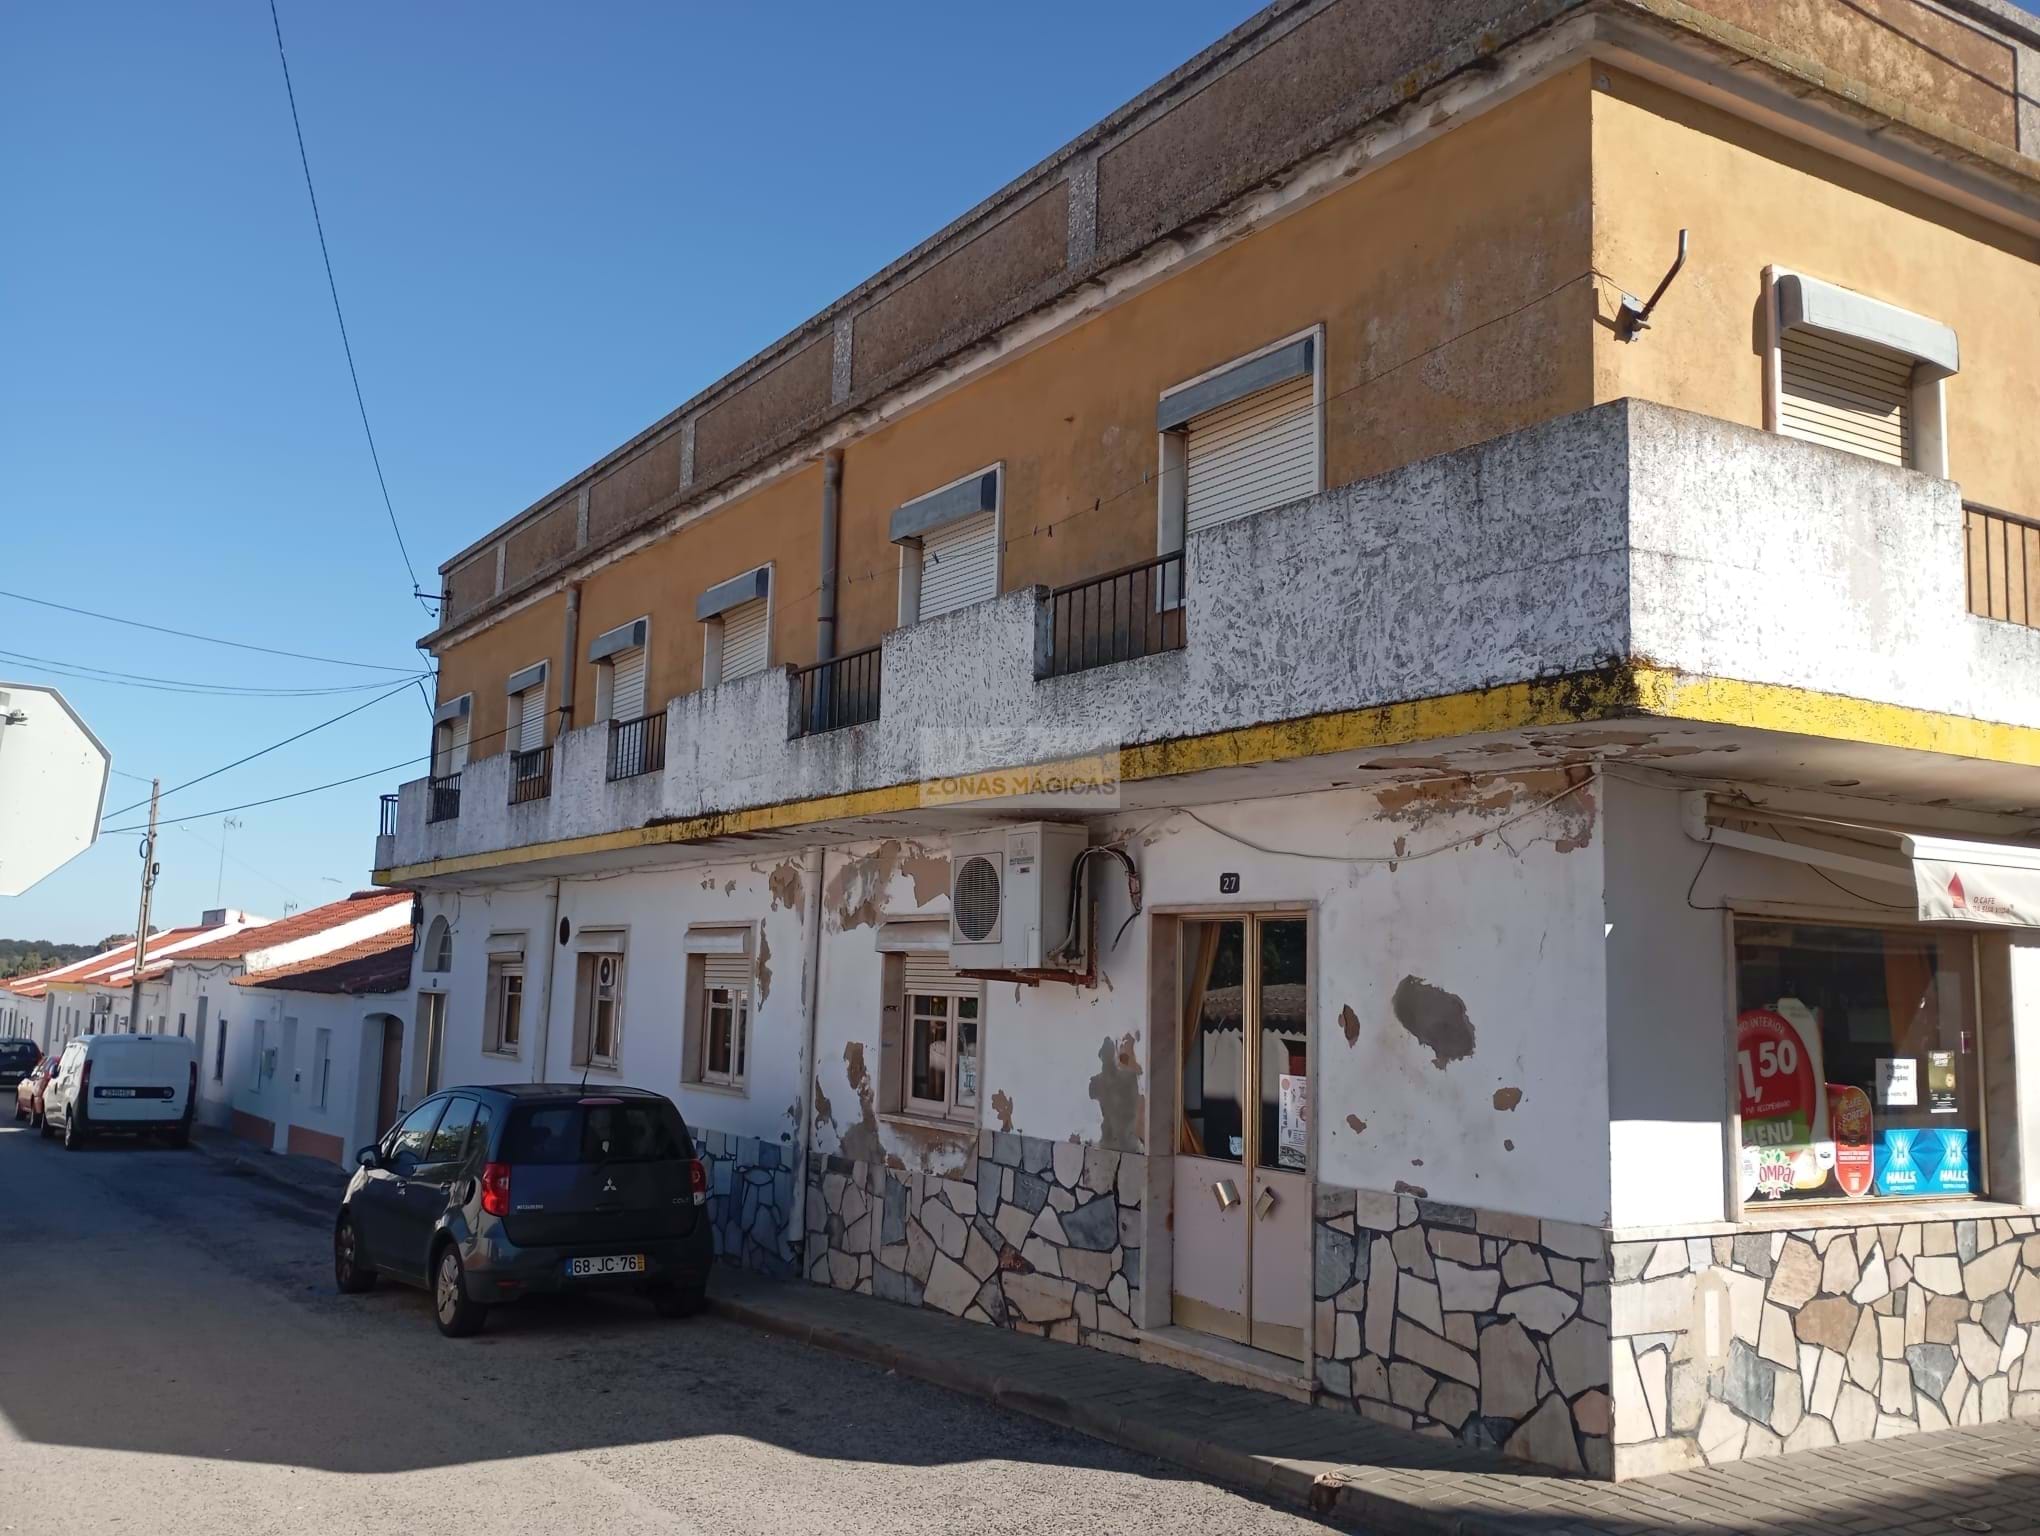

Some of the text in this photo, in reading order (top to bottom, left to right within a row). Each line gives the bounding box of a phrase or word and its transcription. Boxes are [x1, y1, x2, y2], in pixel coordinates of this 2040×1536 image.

[1223, 877, 1237, 890] 27
[1742, 1119, 1793, 1147] MENU
[1886, 1170, 1917, 1185] HALLS
[1940, 1169, 1969, 1183] HALLS
